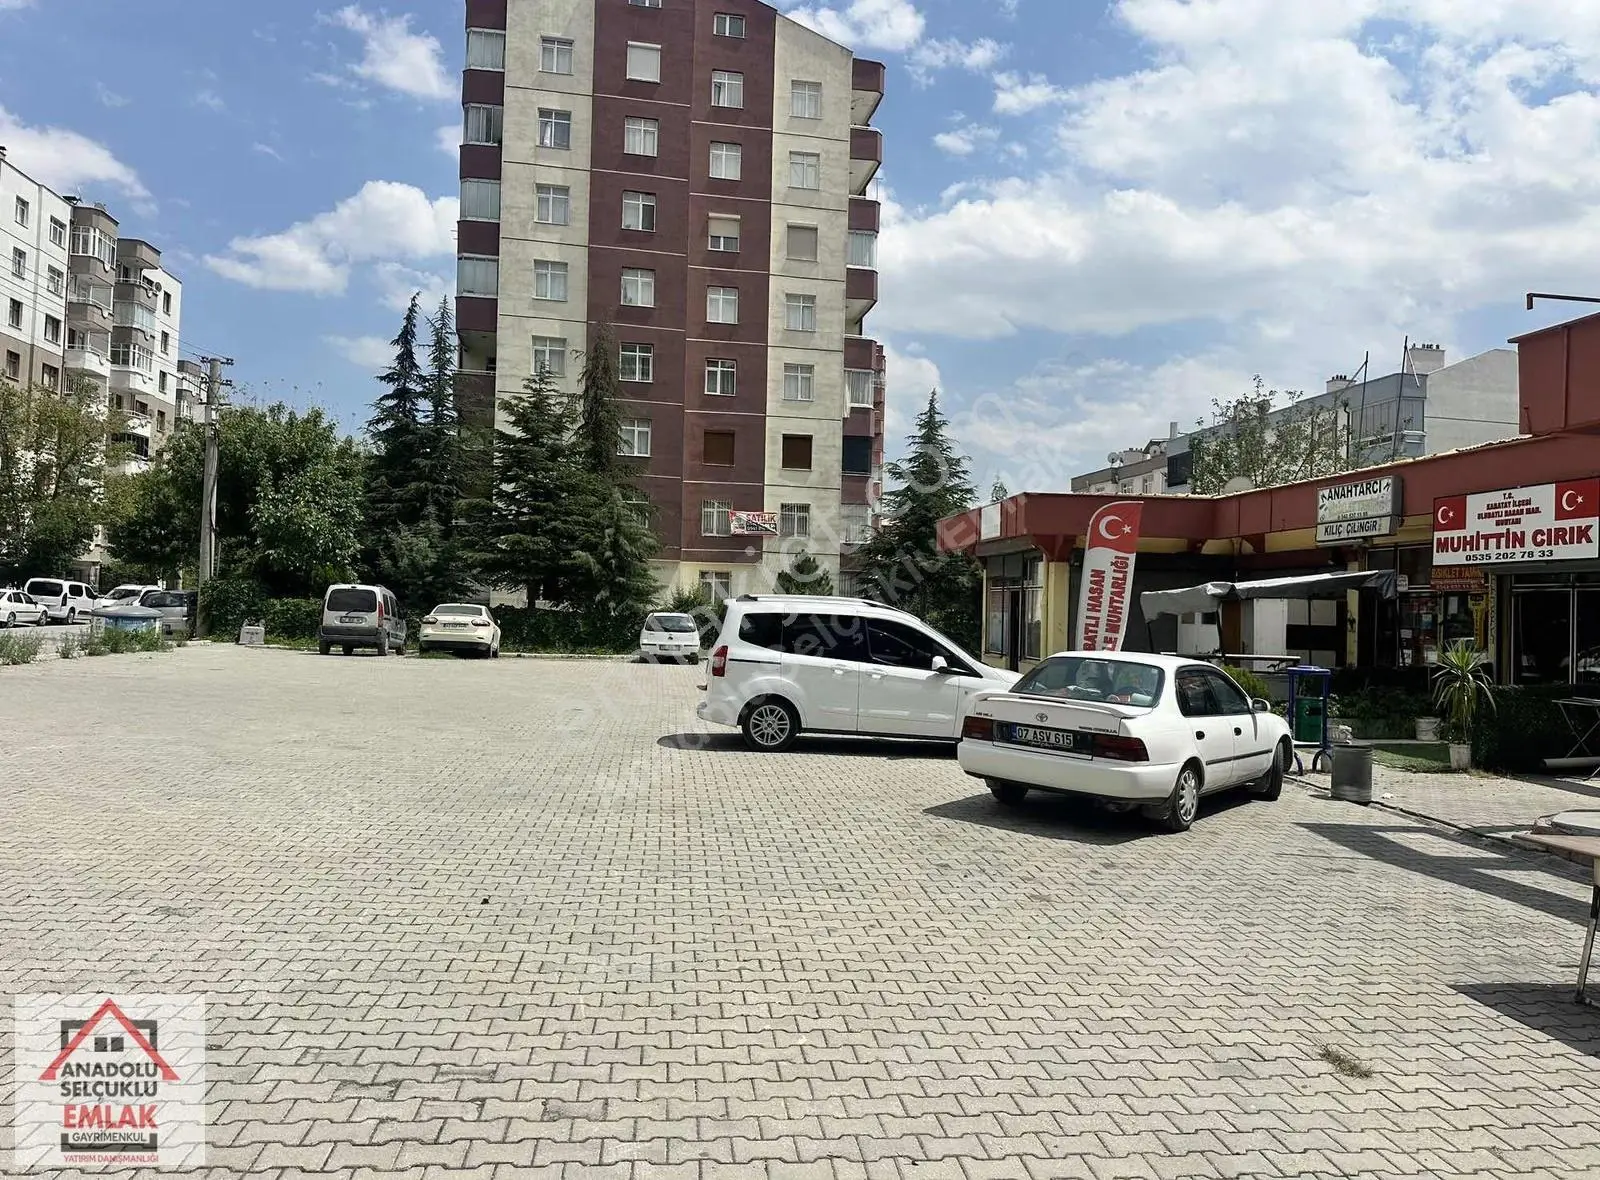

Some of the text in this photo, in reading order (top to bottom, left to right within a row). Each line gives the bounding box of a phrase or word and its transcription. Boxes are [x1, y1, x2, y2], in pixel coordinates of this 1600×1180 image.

[1327, 480, 1382, 501] ANAHTARCI
[1324, 524, 1343, 537] KILIÇ
[1436, 525, 1594, 553] MUHİTTİN CIRIK
[1465, 550, 1553, 562] 0535 202 78 33
[1105, 556, 1130, 634] MUHTARLIĞI
[1082, 569, 1106, 651] BATLI HASAN
[1017, 727, 1029, 739] 07
[1032, 729, 1051, 742] ASV
[1054, 732, 1072, 745] 615
